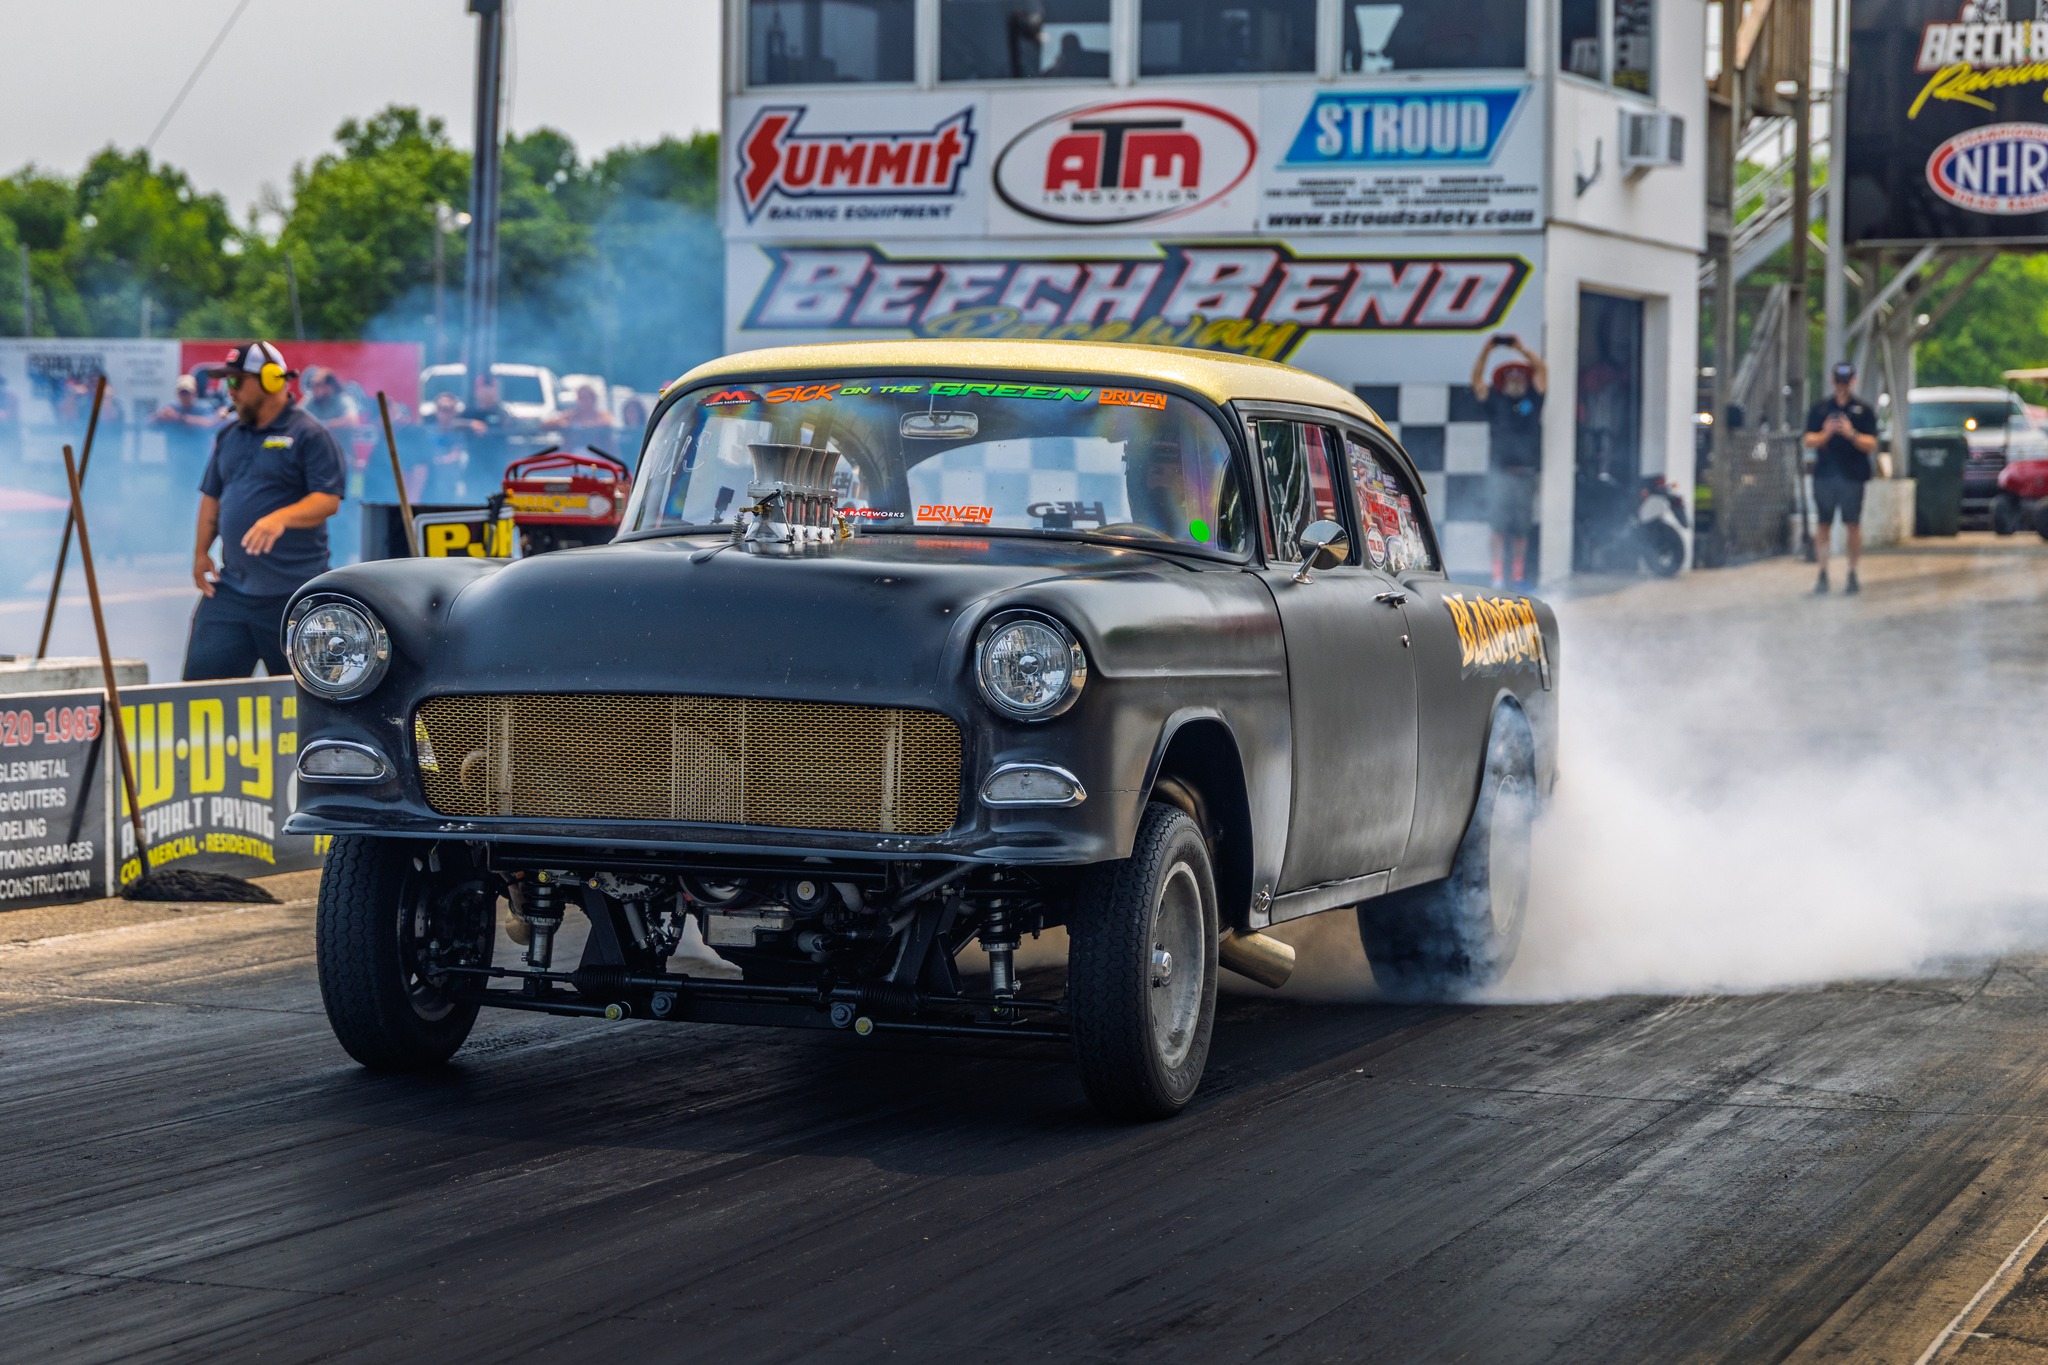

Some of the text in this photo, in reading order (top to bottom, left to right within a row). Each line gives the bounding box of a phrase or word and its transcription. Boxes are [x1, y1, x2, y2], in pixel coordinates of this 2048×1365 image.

[1916, 21, 2024, 71] BEECH
[1315, 97, 1489, 157] STROUD
[1044, 118, 1203, 190] ATM
[1042, 190, 1200, 204] INNOVATION
[768, 204, 953, 221] RACING EQUIPMENT
[1267, 208, 1534, 227] www.stroudsafety.com
[754, 247, 1516, 327] BEECH BEND
[840, 386, 871, 395] ON
[880, 385, 922, 394] THE
[928, 382, 1093, 402] GREEN
[1100, 388, 1168, 405] DRIVEN
[849, 510, 905, 518] RACEWORKS
[917, 505, 994, 519] DRIVEN
[210, 796, 275, 840] PAVING
[205, 833, 276, 865] RESIDENTIAL
[0, 869, 91, 899] CONSTRUCTION
